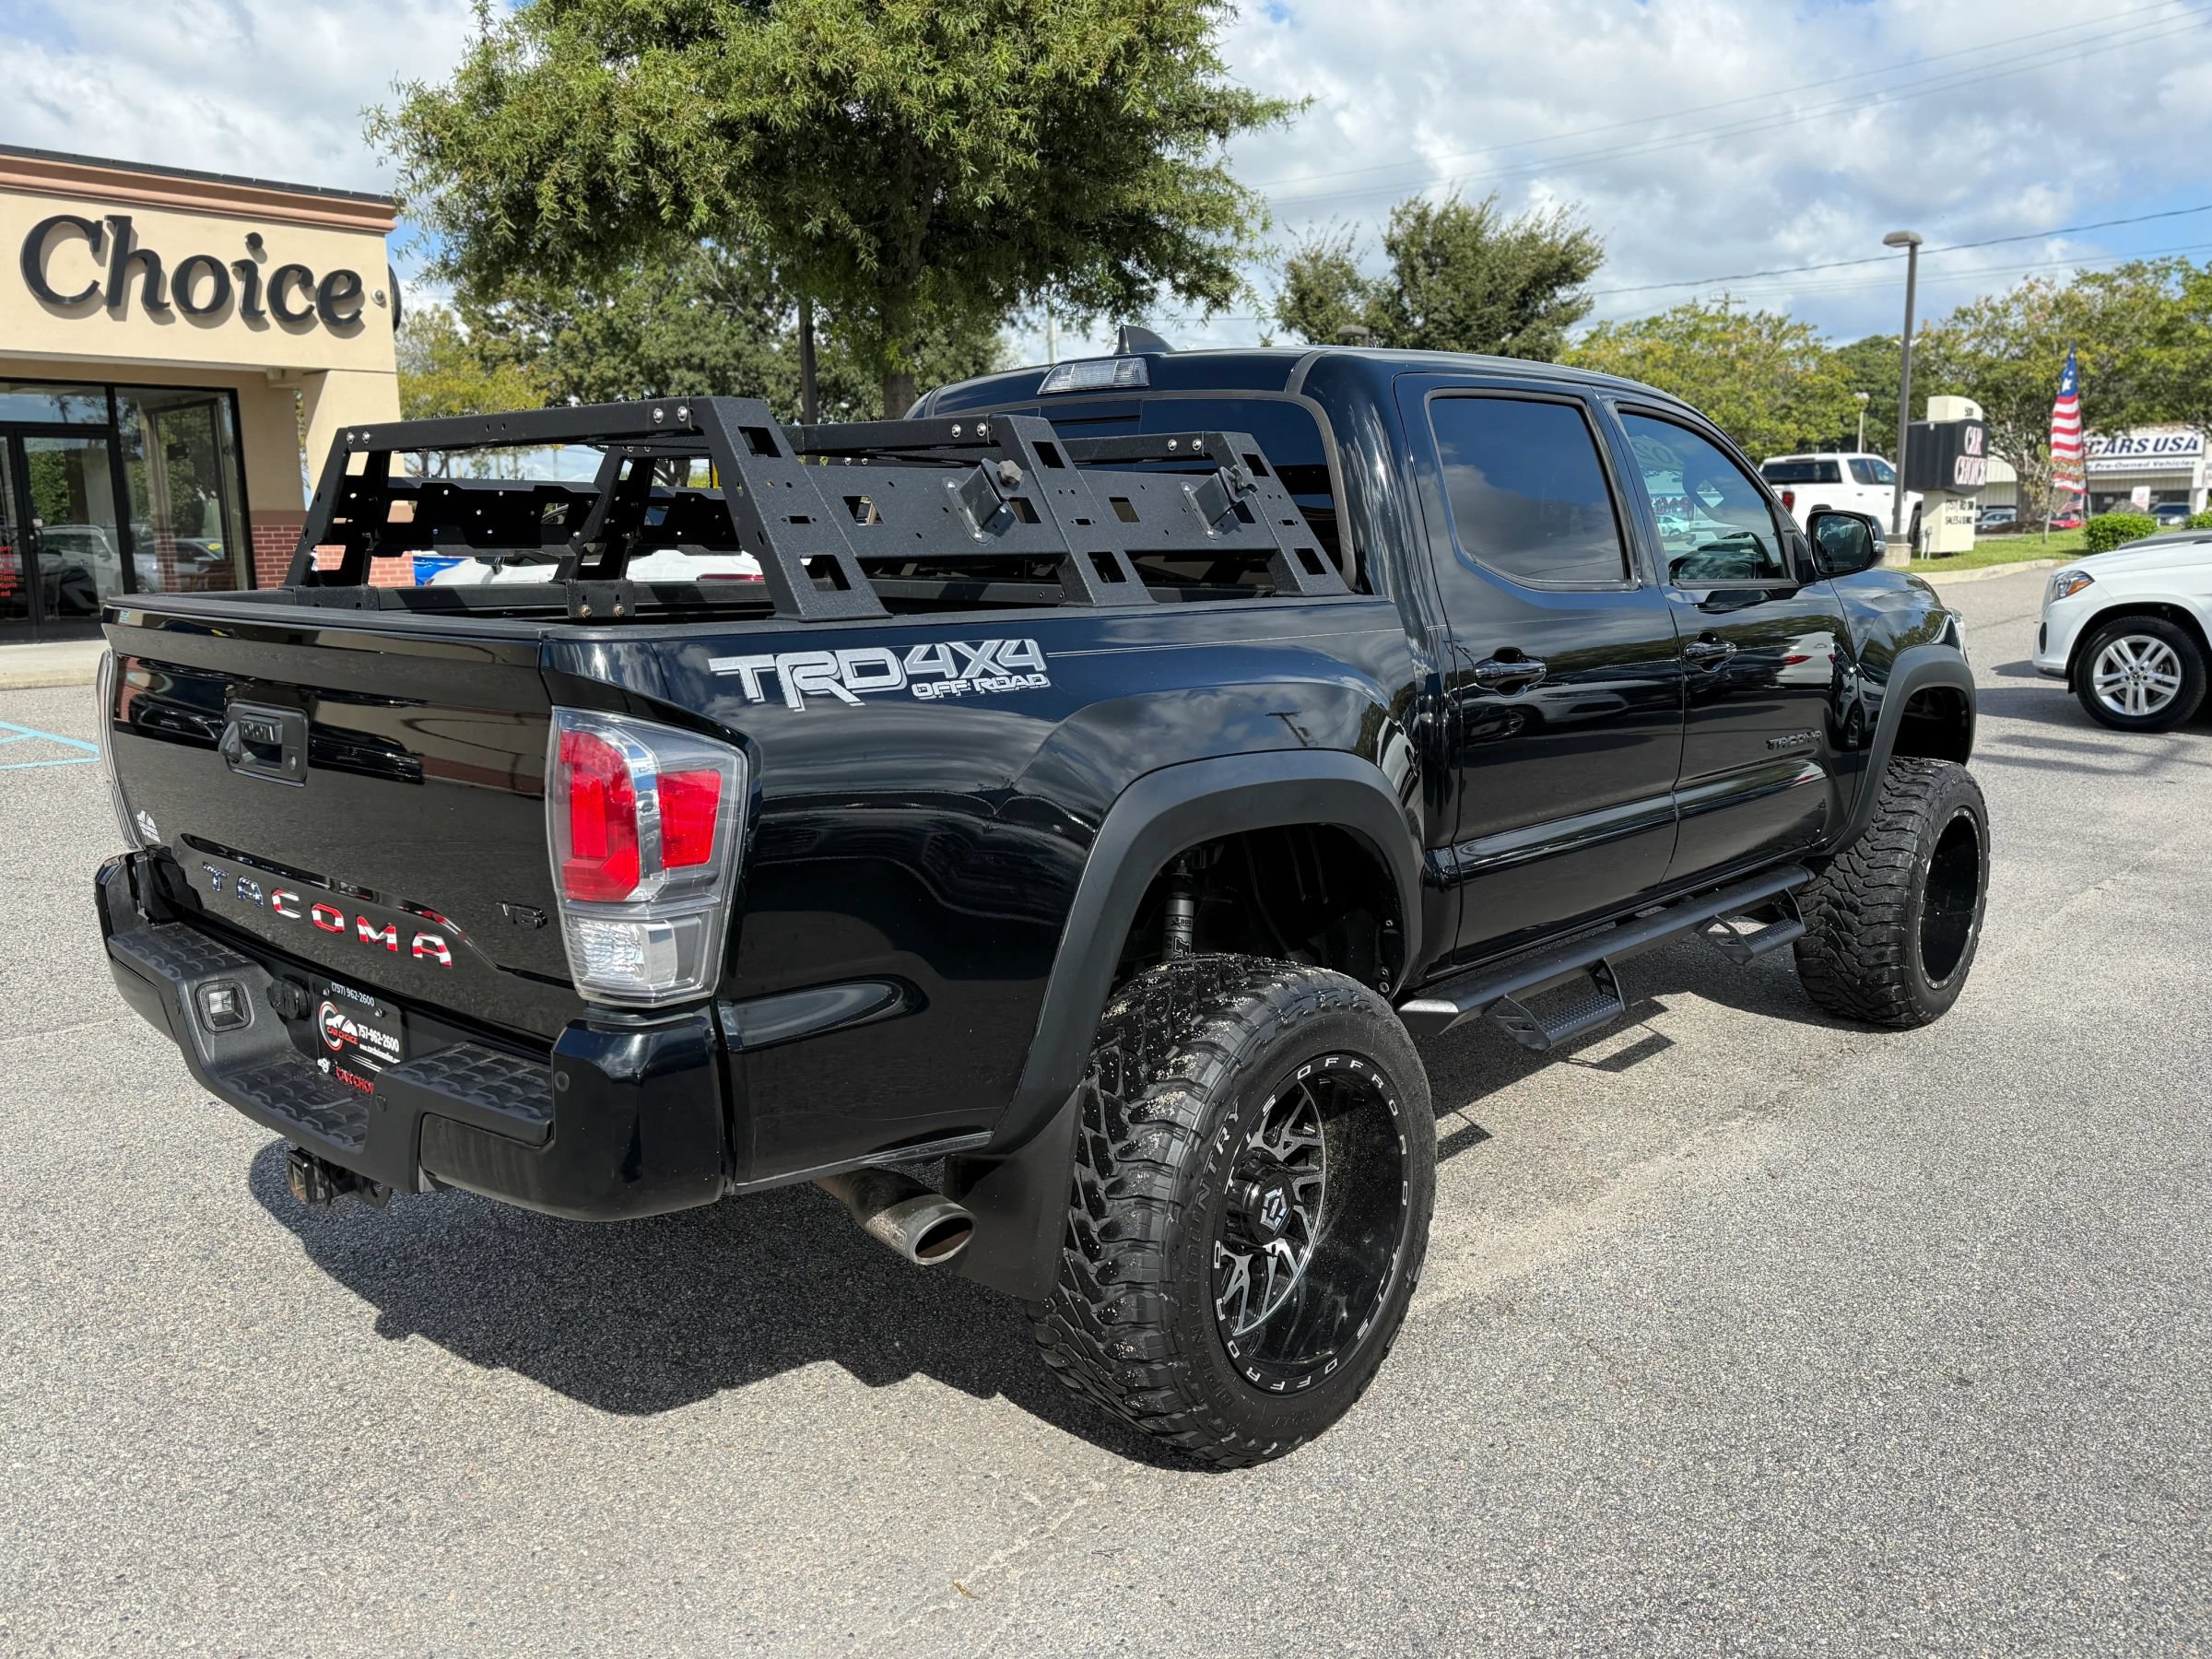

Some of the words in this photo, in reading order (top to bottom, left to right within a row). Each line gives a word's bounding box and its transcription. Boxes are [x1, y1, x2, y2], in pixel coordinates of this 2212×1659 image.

[19, 214, 362, 326] Choice
[1964, 426, 1983, 455] CAR
[2152, 436, 2198, 453] USA
[2094, 460, 2148, 469] Pre-Owned
[2152, 459, 2196, 467] Vehicles
[708, 646, 907, 712] TRD
[905, 638, 1047, 679] 4X4
[912, 678, 971, 700] OFF
[972, 673, 1051, 694] ROAD
[1766, 730, 1822, 749] TACOMA
[202, 861, 453, 967] TACOMA
[331, 981, 347, 996] (757)
[346, 986, 375, 1007] 962-2600
[325, 1026, 339, 1038] CAR
[337, 1030, 360, 1045] CHOICE
[357, 1023, 400, 1053] 757-962-2600
